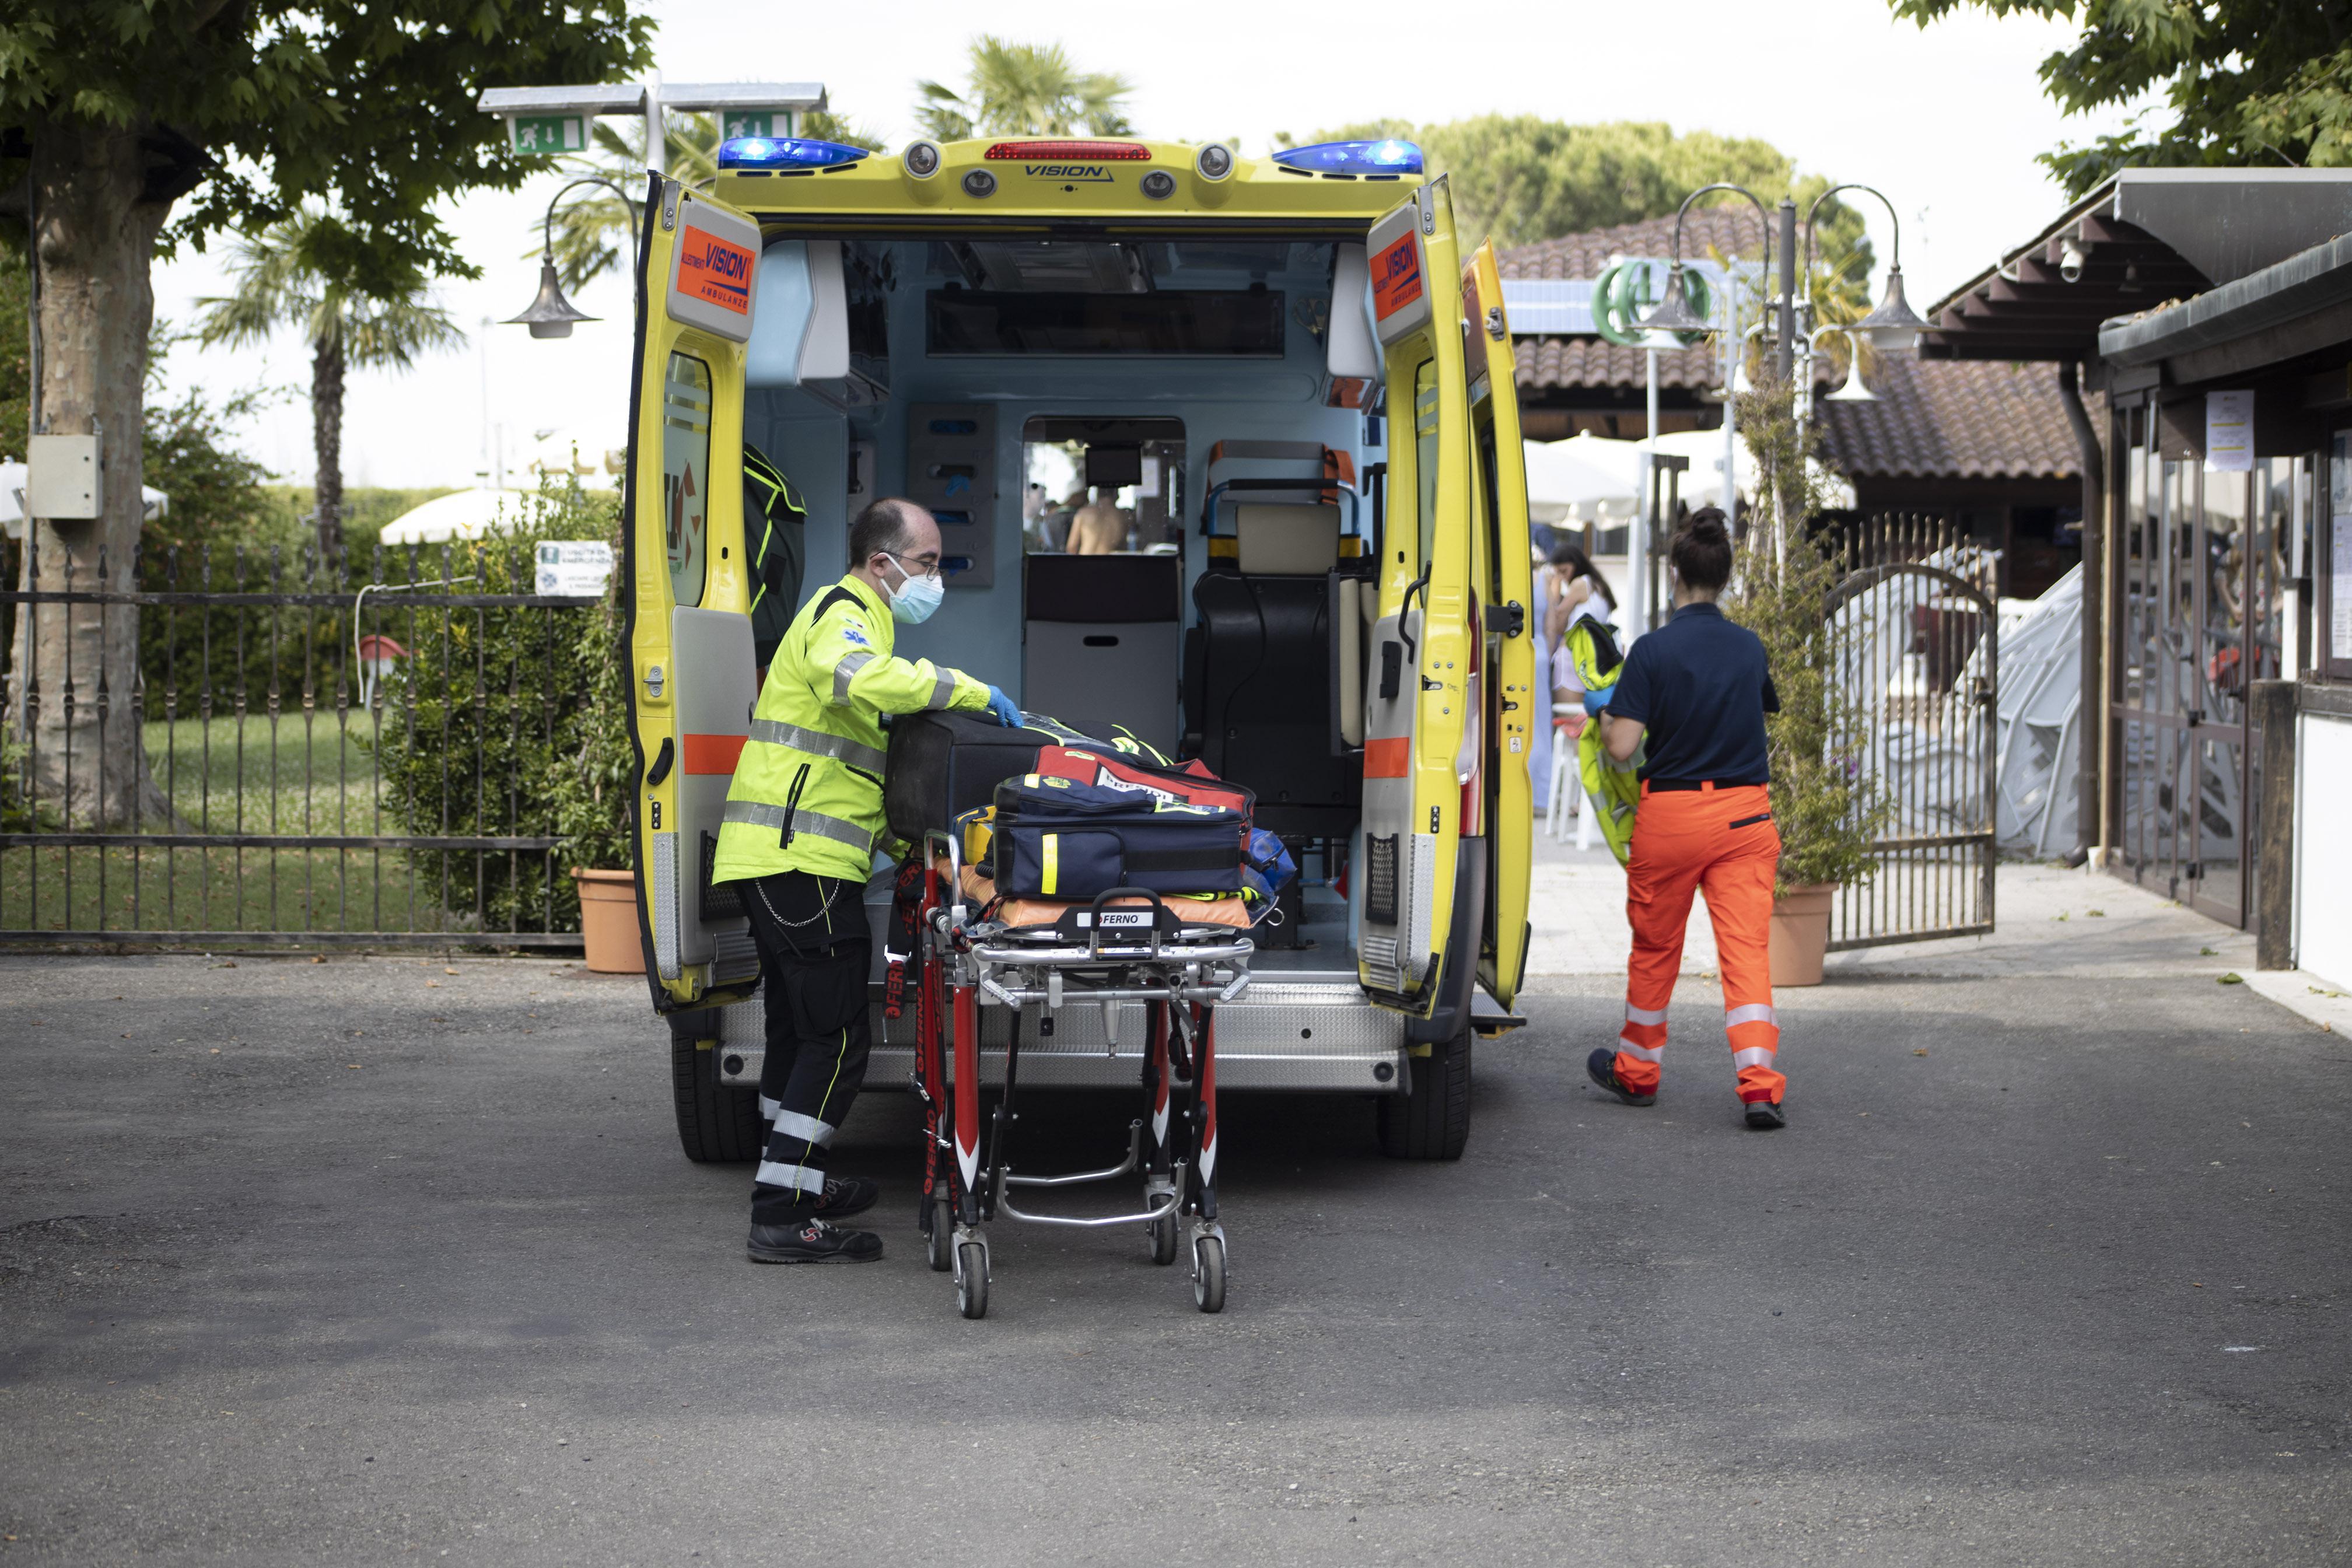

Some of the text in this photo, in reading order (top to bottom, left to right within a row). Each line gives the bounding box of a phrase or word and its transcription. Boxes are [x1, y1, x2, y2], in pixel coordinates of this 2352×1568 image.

[1026, 166, 1103, 177] VISION
[706, 243, 747, 280] VISION
[1385, 240, 1413, 281] VISION
[701, 286, 747, 309] AMBULANZE
[1103, 915, 1138, 924] FERNO
[886, 960, 904, 1006] FERN
